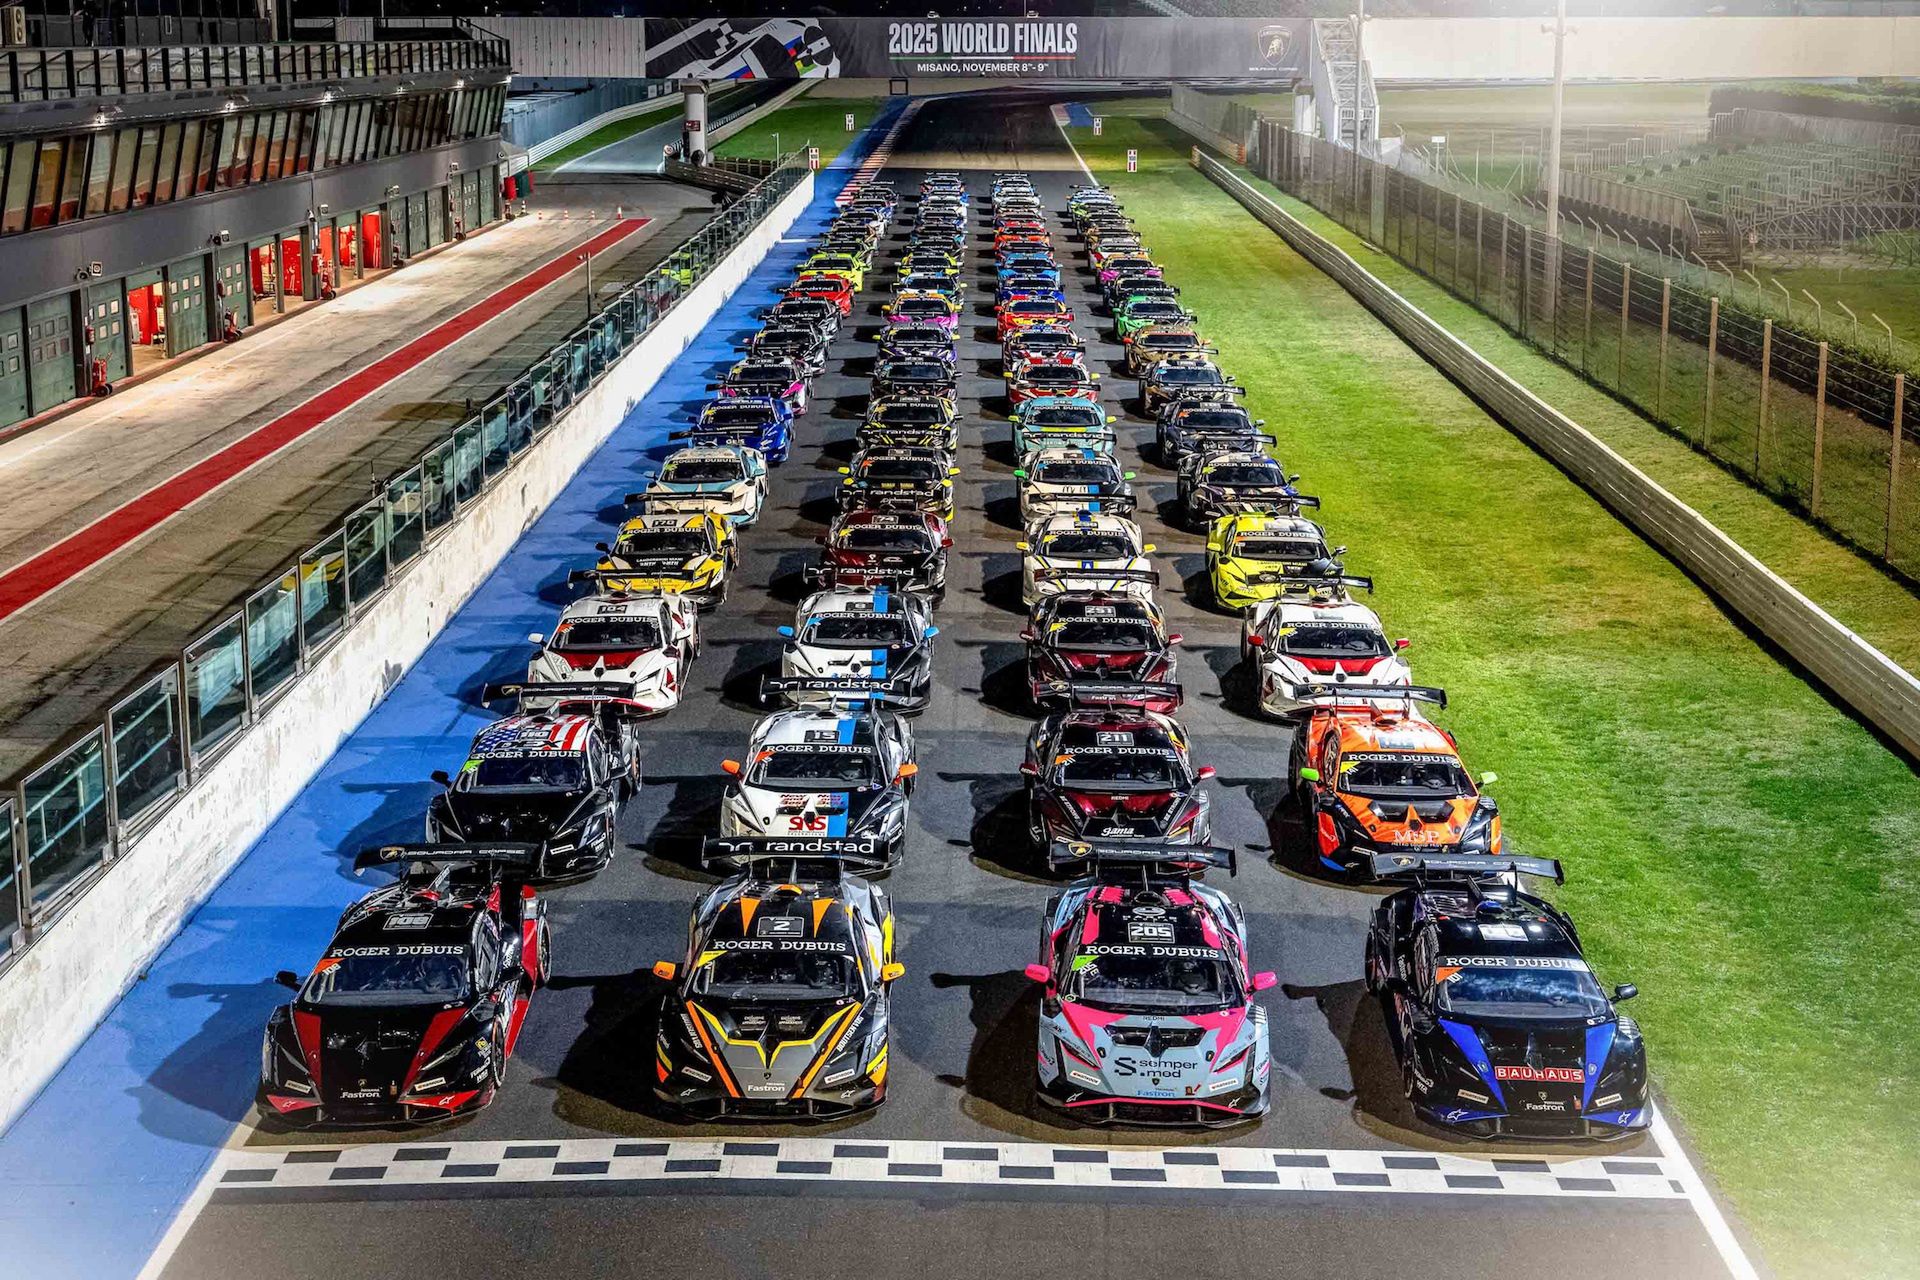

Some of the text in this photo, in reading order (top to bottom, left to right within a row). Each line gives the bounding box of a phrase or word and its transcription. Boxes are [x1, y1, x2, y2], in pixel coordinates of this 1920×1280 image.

[889, 22, 1078, 54] 2025 WORLD FINALS
[917, 63, 961, 73] MISANO,
[963, 63, 1020, 72] NOVEMBER
[870, 489, 934, 497] randstad
[840, 567, 914, 576] randstad
[600, 605, 627, 613] 104
[1101, 617, 1145, 625] DUBUIS
[806, 680, 894, 691] randstad
[813, 731, 836, 740] 15
[1100, 733, 1127, 742] 211
[766, 745, 872, 754] ROGER DUBUIS
[1064, 747, 1170, 756] ROGER DUBUIS
[476, 751, 523, 759] ROGER
[766, 838, 875, 854] randstad
[773, 920, 791, 931] 2
[1130, 926, 1172, 937] 205
[713, 941, 847, 952] ROGER DUBUIS
[330, 945, 464, 958] ROGER DUBUIS
[1085, 945, 1220, 958] ROGER DUBUIS
[704, 962, 713, 970] 2
[1446, 957, 1509, 967] ROGER
[1079, 961, 1098, 975] 205
[1447, 972, 1463, 983] 101
[1139, 1059, 1198, 1071] semper
[1497, 1066, 1583, 1081] BAUHAUS
[747, 1084, 785, 1092] Fastron
[341, 1091, 380, 1099] Fastron
[1136, 1089, 1176, 1098] Fastron
[1526, 1103, 1566, 1111] Fastron
